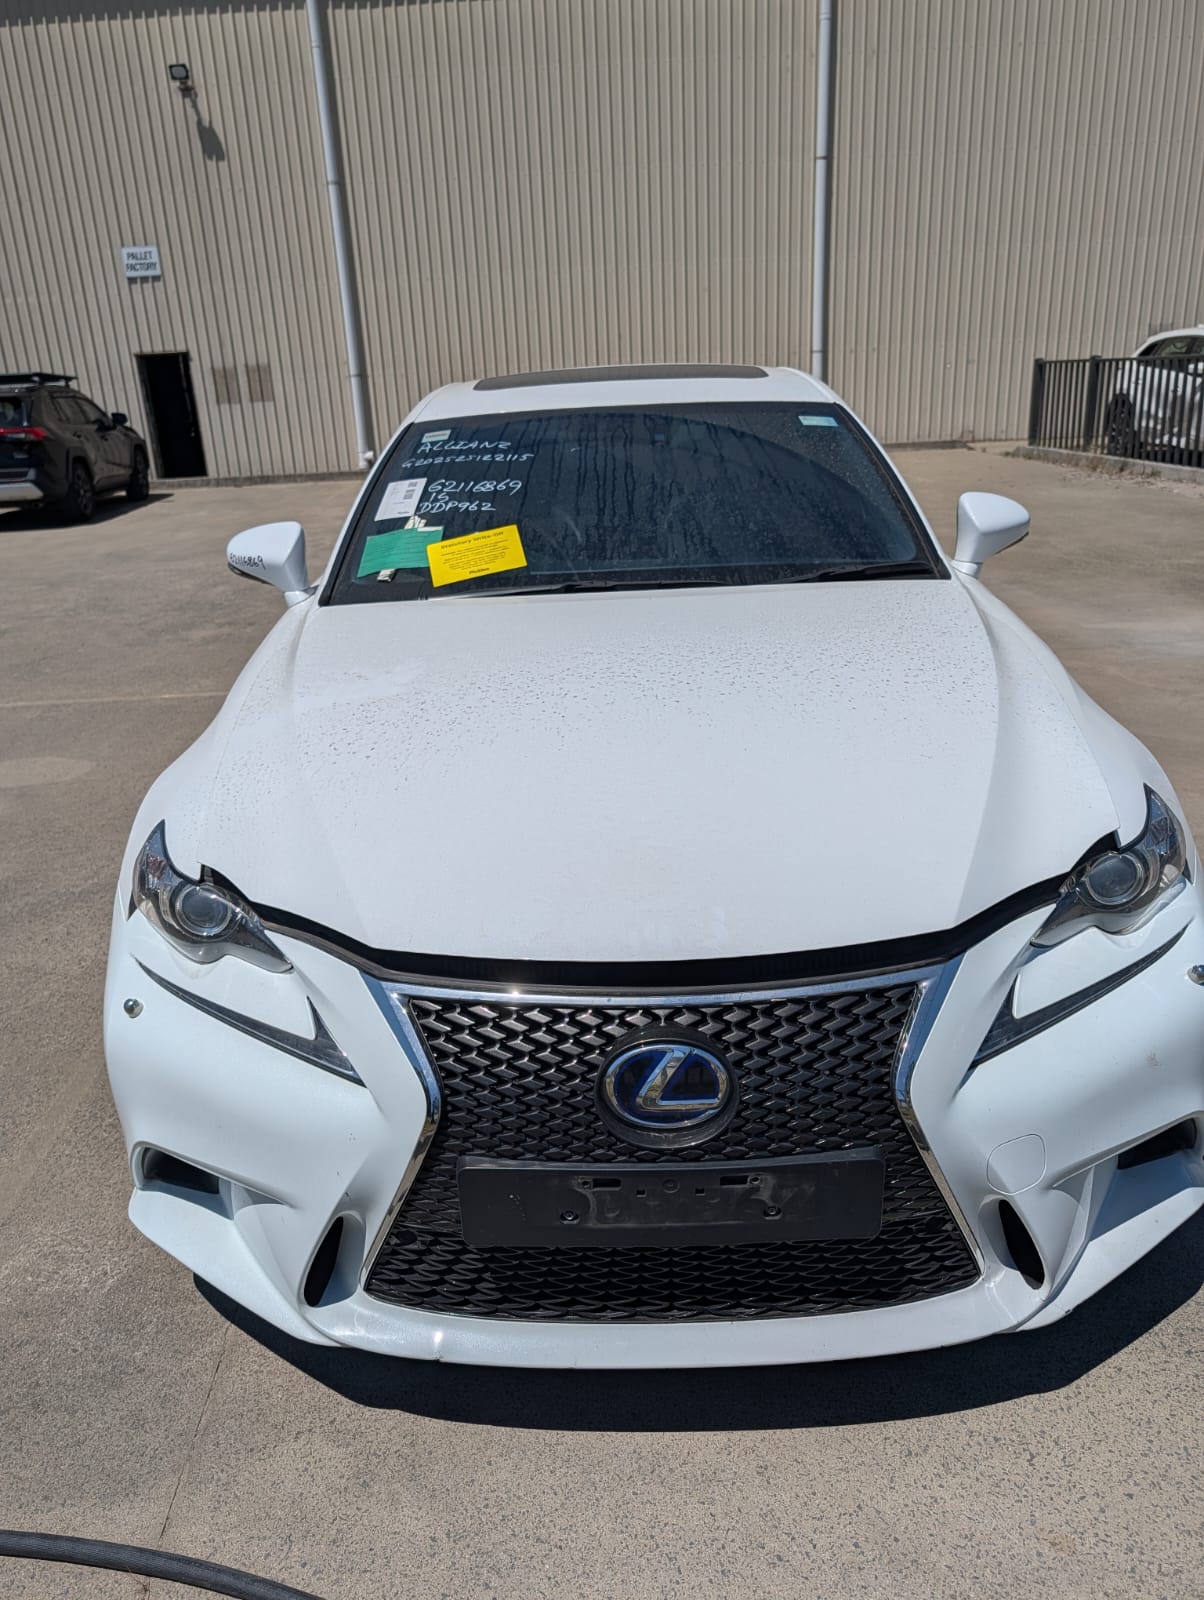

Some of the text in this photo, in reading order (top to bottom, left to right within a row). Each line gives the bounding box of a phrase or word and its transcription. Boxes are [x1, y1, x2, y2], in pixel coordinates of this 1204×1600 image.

[126, 250, 153, 261] PALLET
[125, 262, 158, 272] FACTORY
[417, 441, 511, 454] ALLIANZ
[428, 479, 522, 496] 62116869
[416, 500, 496, 514] DDP962
